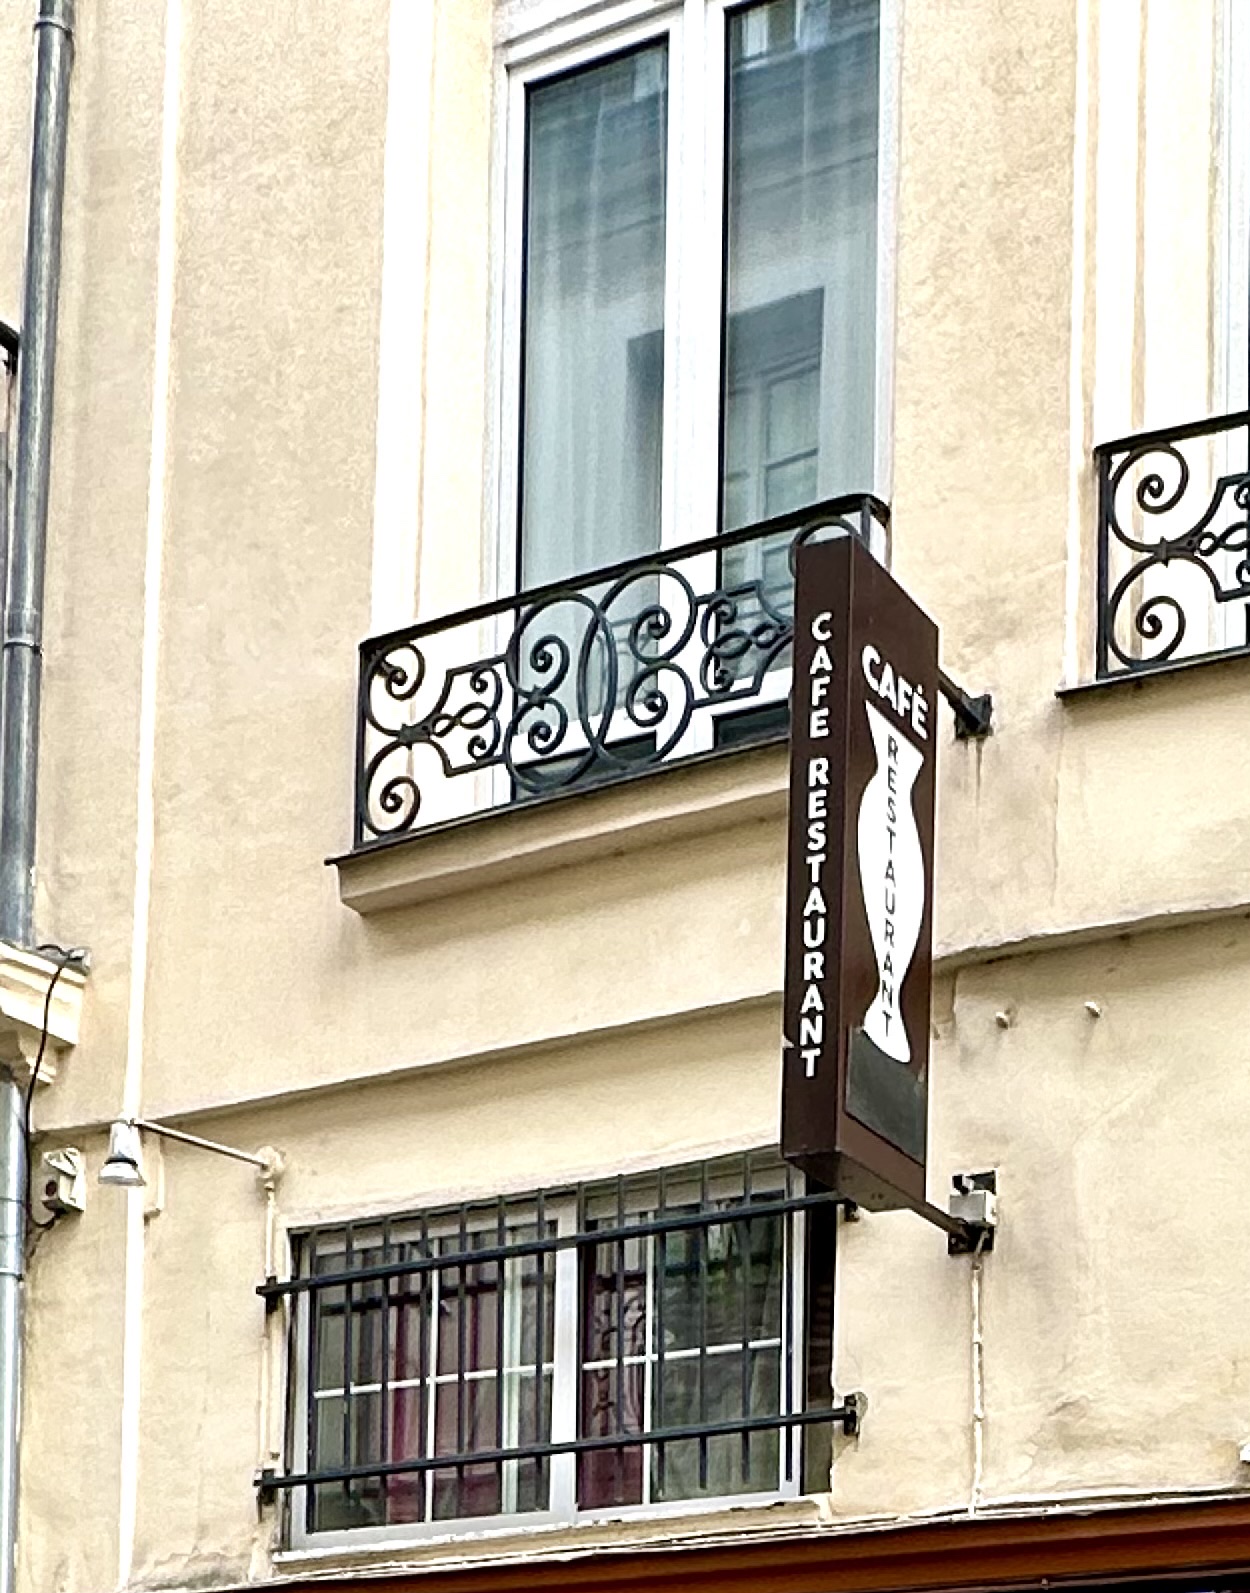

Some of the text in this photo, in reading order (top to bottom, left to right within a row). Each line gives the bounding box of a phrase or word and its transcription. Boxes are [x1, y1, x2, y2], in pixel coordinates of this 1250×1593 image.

[801, 611, 832, 1078] CAFE RESTAURANT
[883, 735, 899, 1038] RESTAURANT
